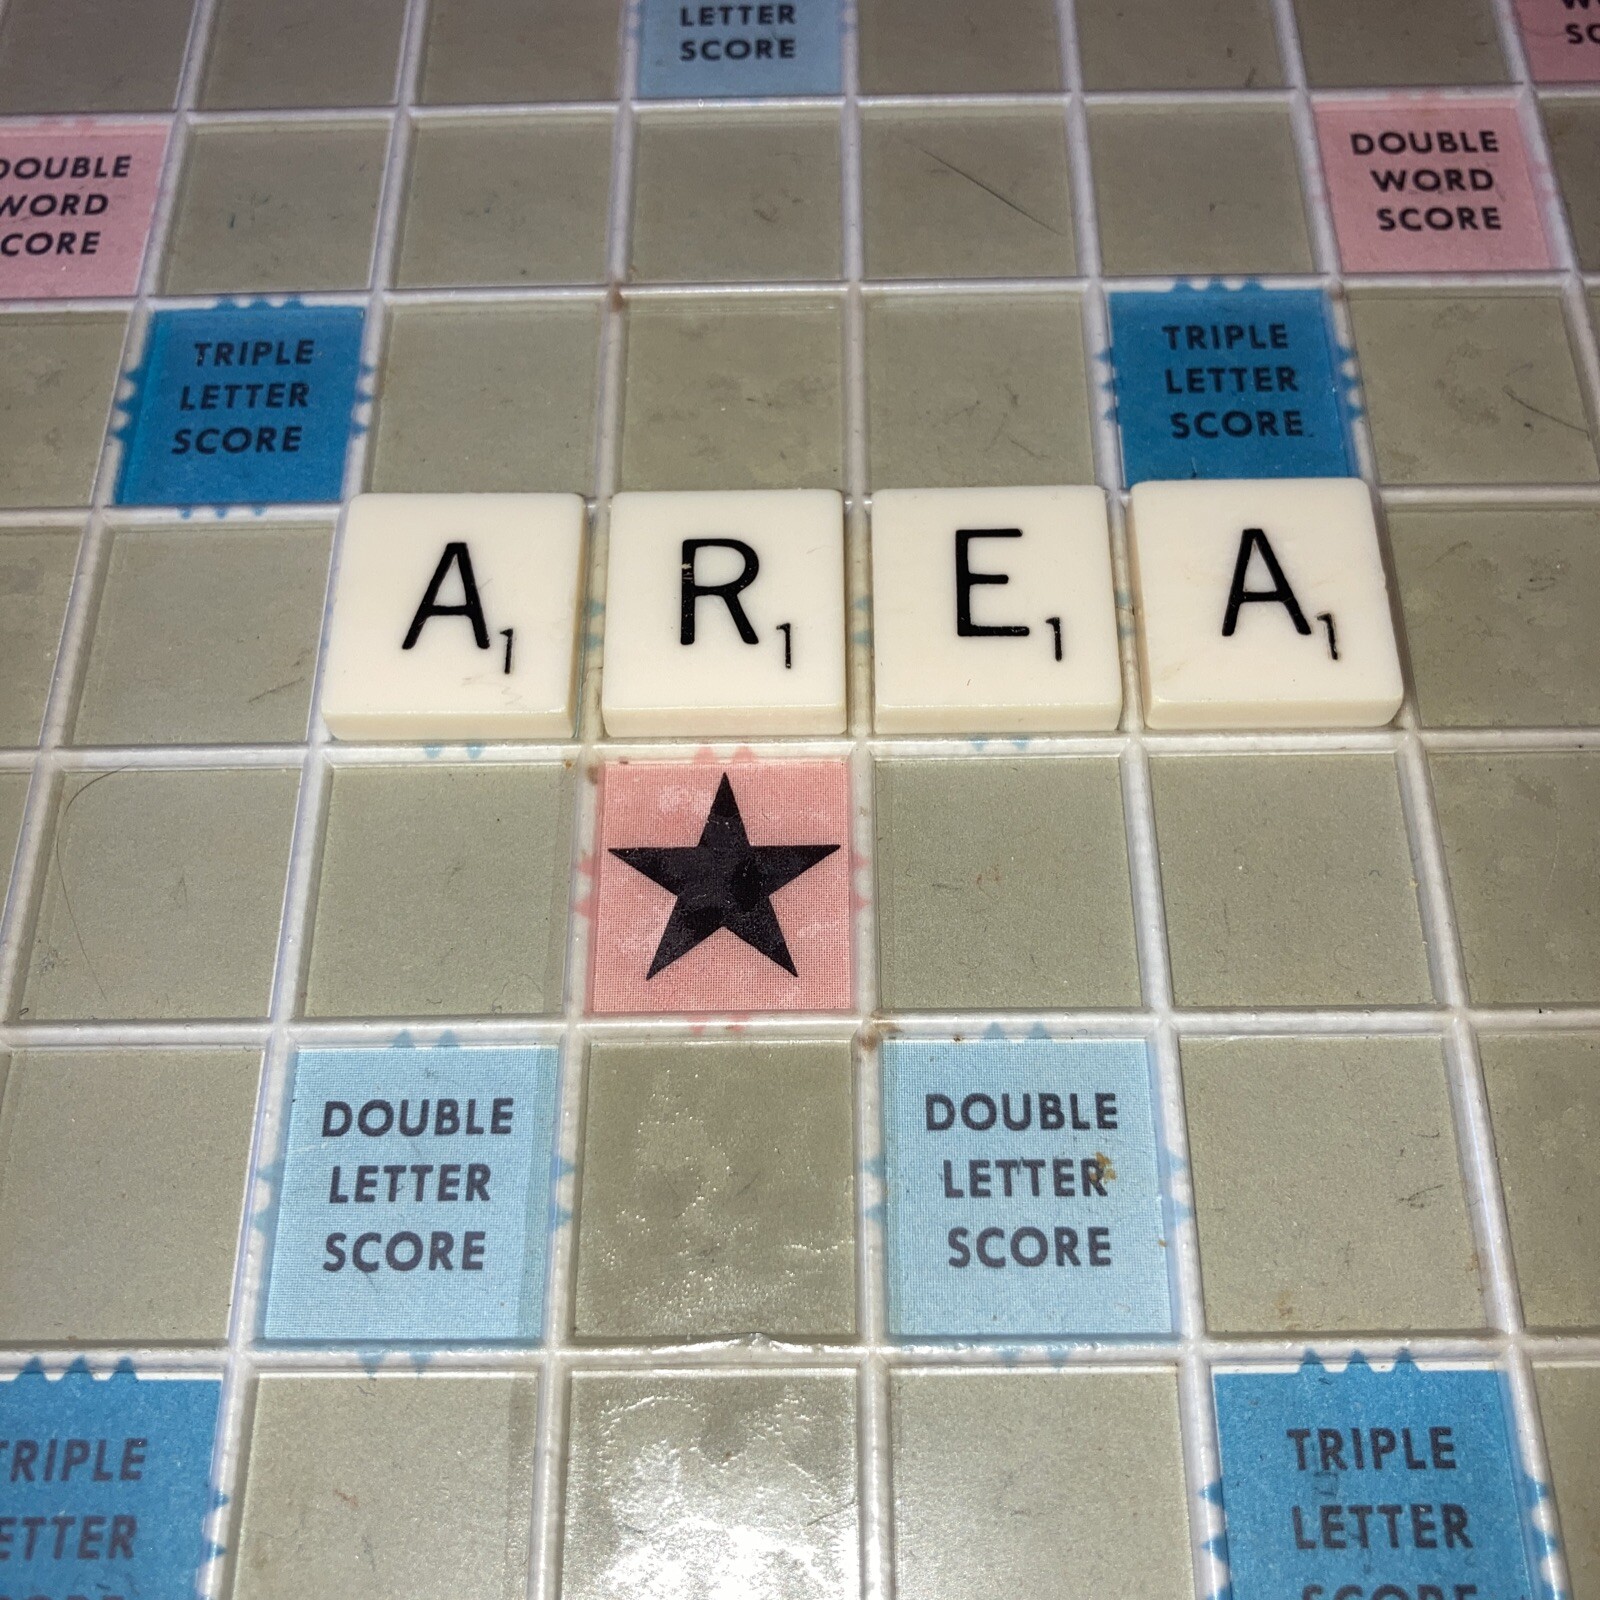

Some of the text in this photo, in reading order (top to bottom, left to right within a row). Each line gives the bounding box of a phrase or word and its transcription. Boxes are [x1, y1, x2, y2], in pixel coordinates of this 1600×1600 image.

[680, 5, 796, 27] LETTER
[680, 38, 796, 61] SCORE
[1350, 130, 1500, 156] DOUBLE
[1370, 168, 1493, 192] WORD
[1377, 206, 1502, 232] SCORE
[1162, 322, 1289, 351] TRIPLE
[194, 338, 315, 368] TRIPLE
[1165, 364, 1299, 395] LETTER
[180, 382, 310, 412] LETTER
[171, 425, 303, 455] SCORE
[1170, 410, 1304, 440] SCORE
[322, 1098, 514, 1137] DOUBLE
[925, 1092, 1118, 1131] DOUBLE
[329, 1163, 492, 1204] LETTER
[943, 1158, 1108, 1198] LETTER
[322, 1231, 486, 1273] SCORE
[948, 1226, 1112, 1268] SCORE
[1286, 1426, 1457, 1471] TRIPLE
[1291, 1503, 1474, 1550] LETTER
